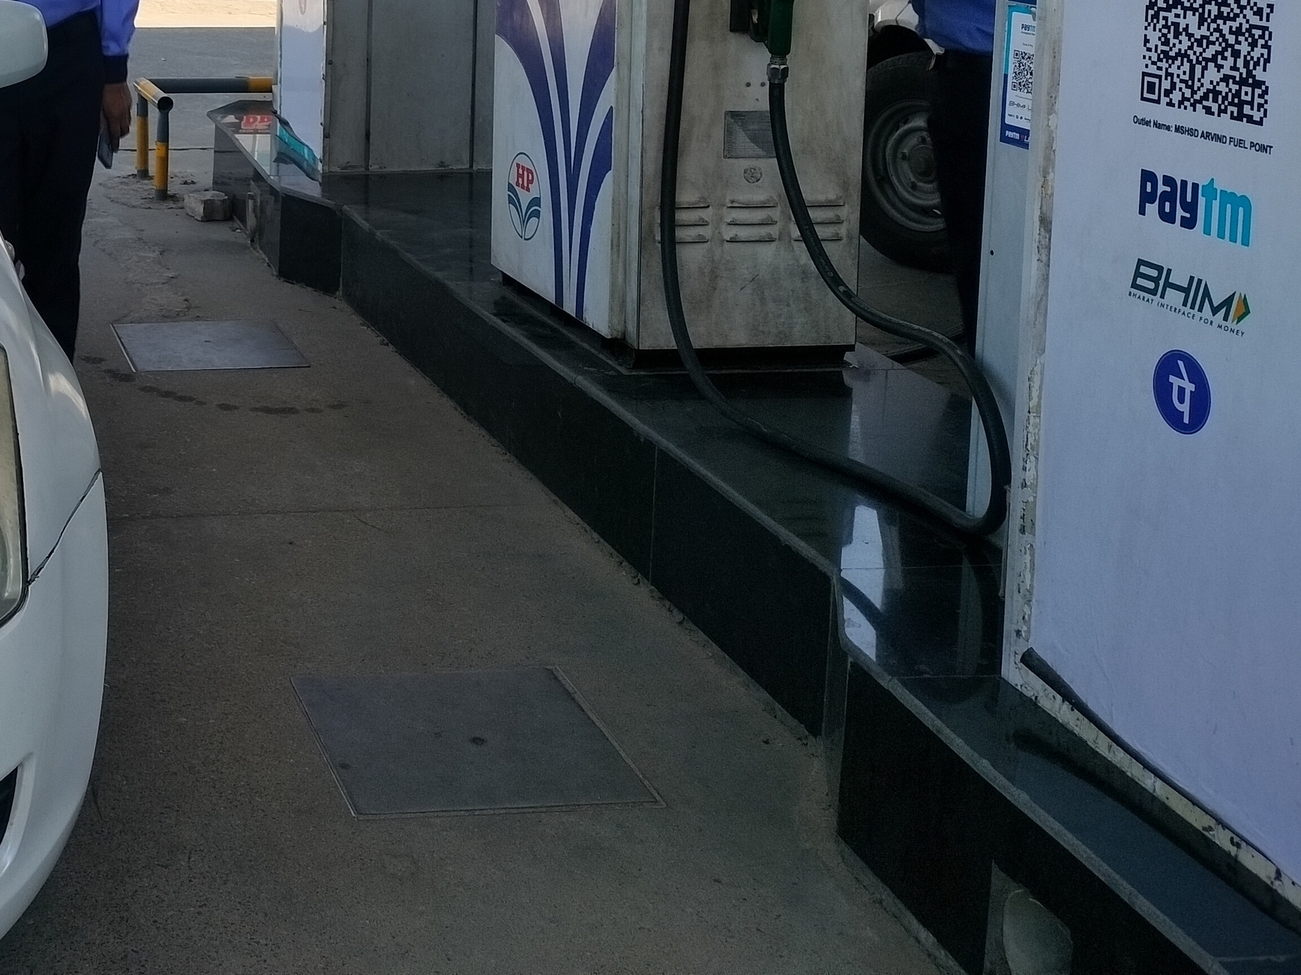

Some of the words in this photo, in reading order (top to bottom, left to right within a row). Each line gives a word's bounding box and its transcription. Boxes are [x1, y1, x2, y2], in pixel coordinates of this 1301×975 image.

[1133, 115, 1152, 128] Outlet
[1152, 119, 1173, 132] Name:
[1174, 124, 1199, 138] MSHSD
[1200, 130, 1228, 145] ARVIND
[1228, 136, 1248, 150] FUEL
[1249, 141, 1274, 155] POINT
[514, 162, 535, 193] HP
[1130, 258, 1238, 323] BHIM
[1128, 290, 1154, 305] BHARAT
[1156, 302, 1196, 321] INTERFACE
[1199, 316, 1214, 327] FOR
[1216, 323, 1245, 338] MONEY
